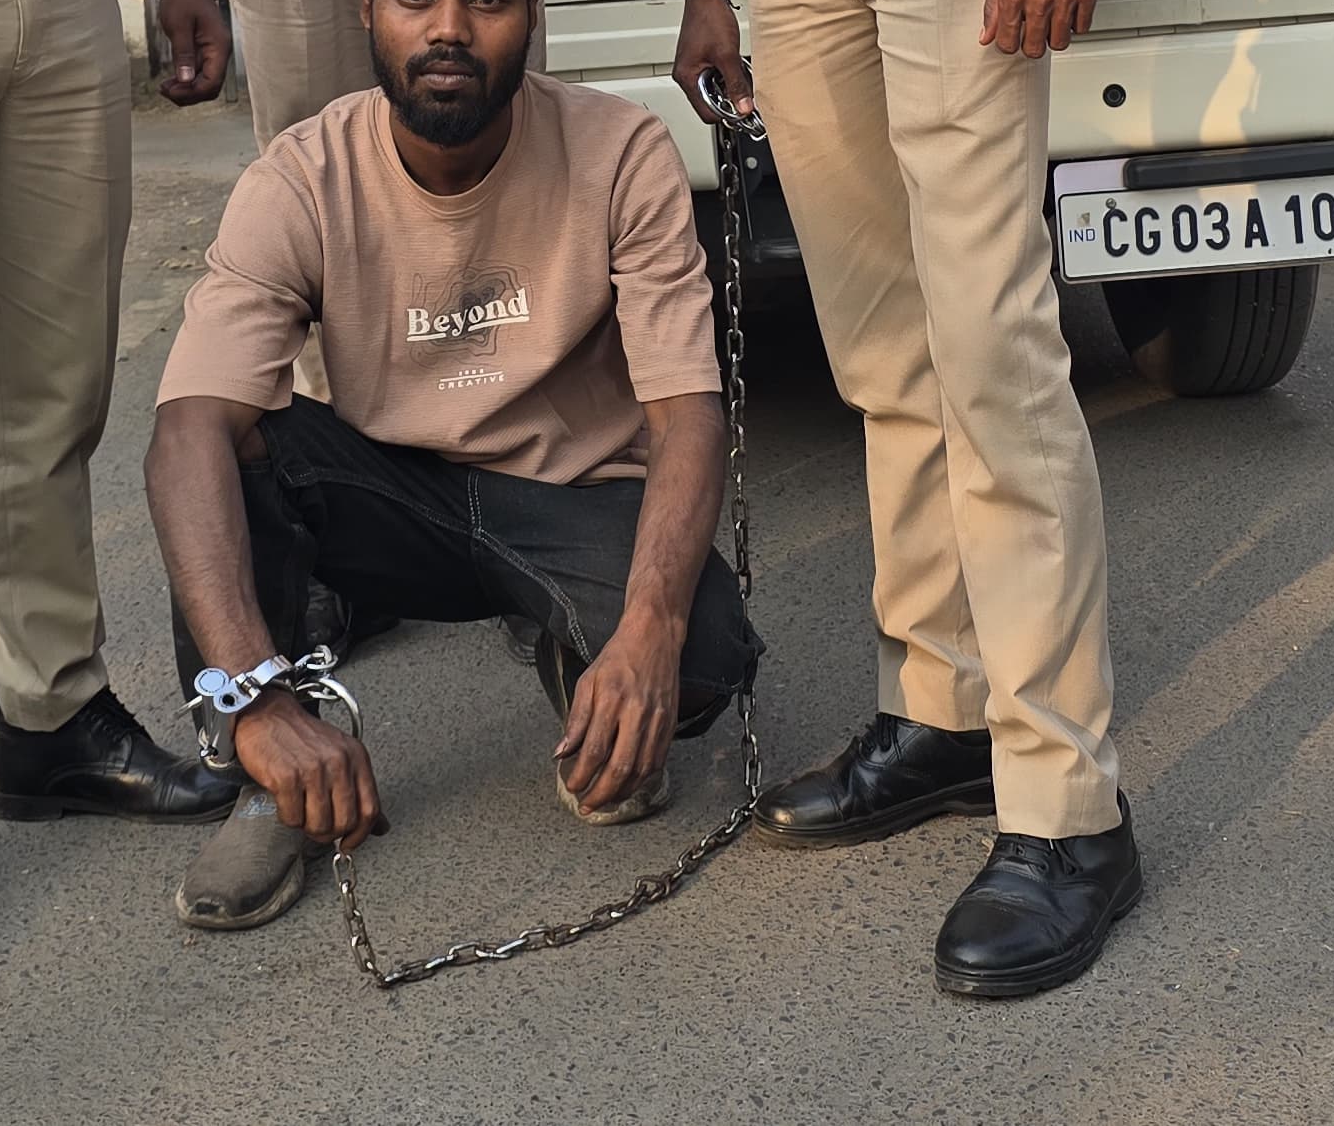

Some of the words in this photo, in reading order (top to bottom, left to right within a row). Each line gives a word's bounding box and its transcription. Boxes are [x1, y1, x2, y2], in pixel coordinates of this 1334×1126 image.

[1068, 228, 1097, 243] IND
[407, 287, 529, 337] Beyond
[438, 375, 505, 390] CREATIVE
